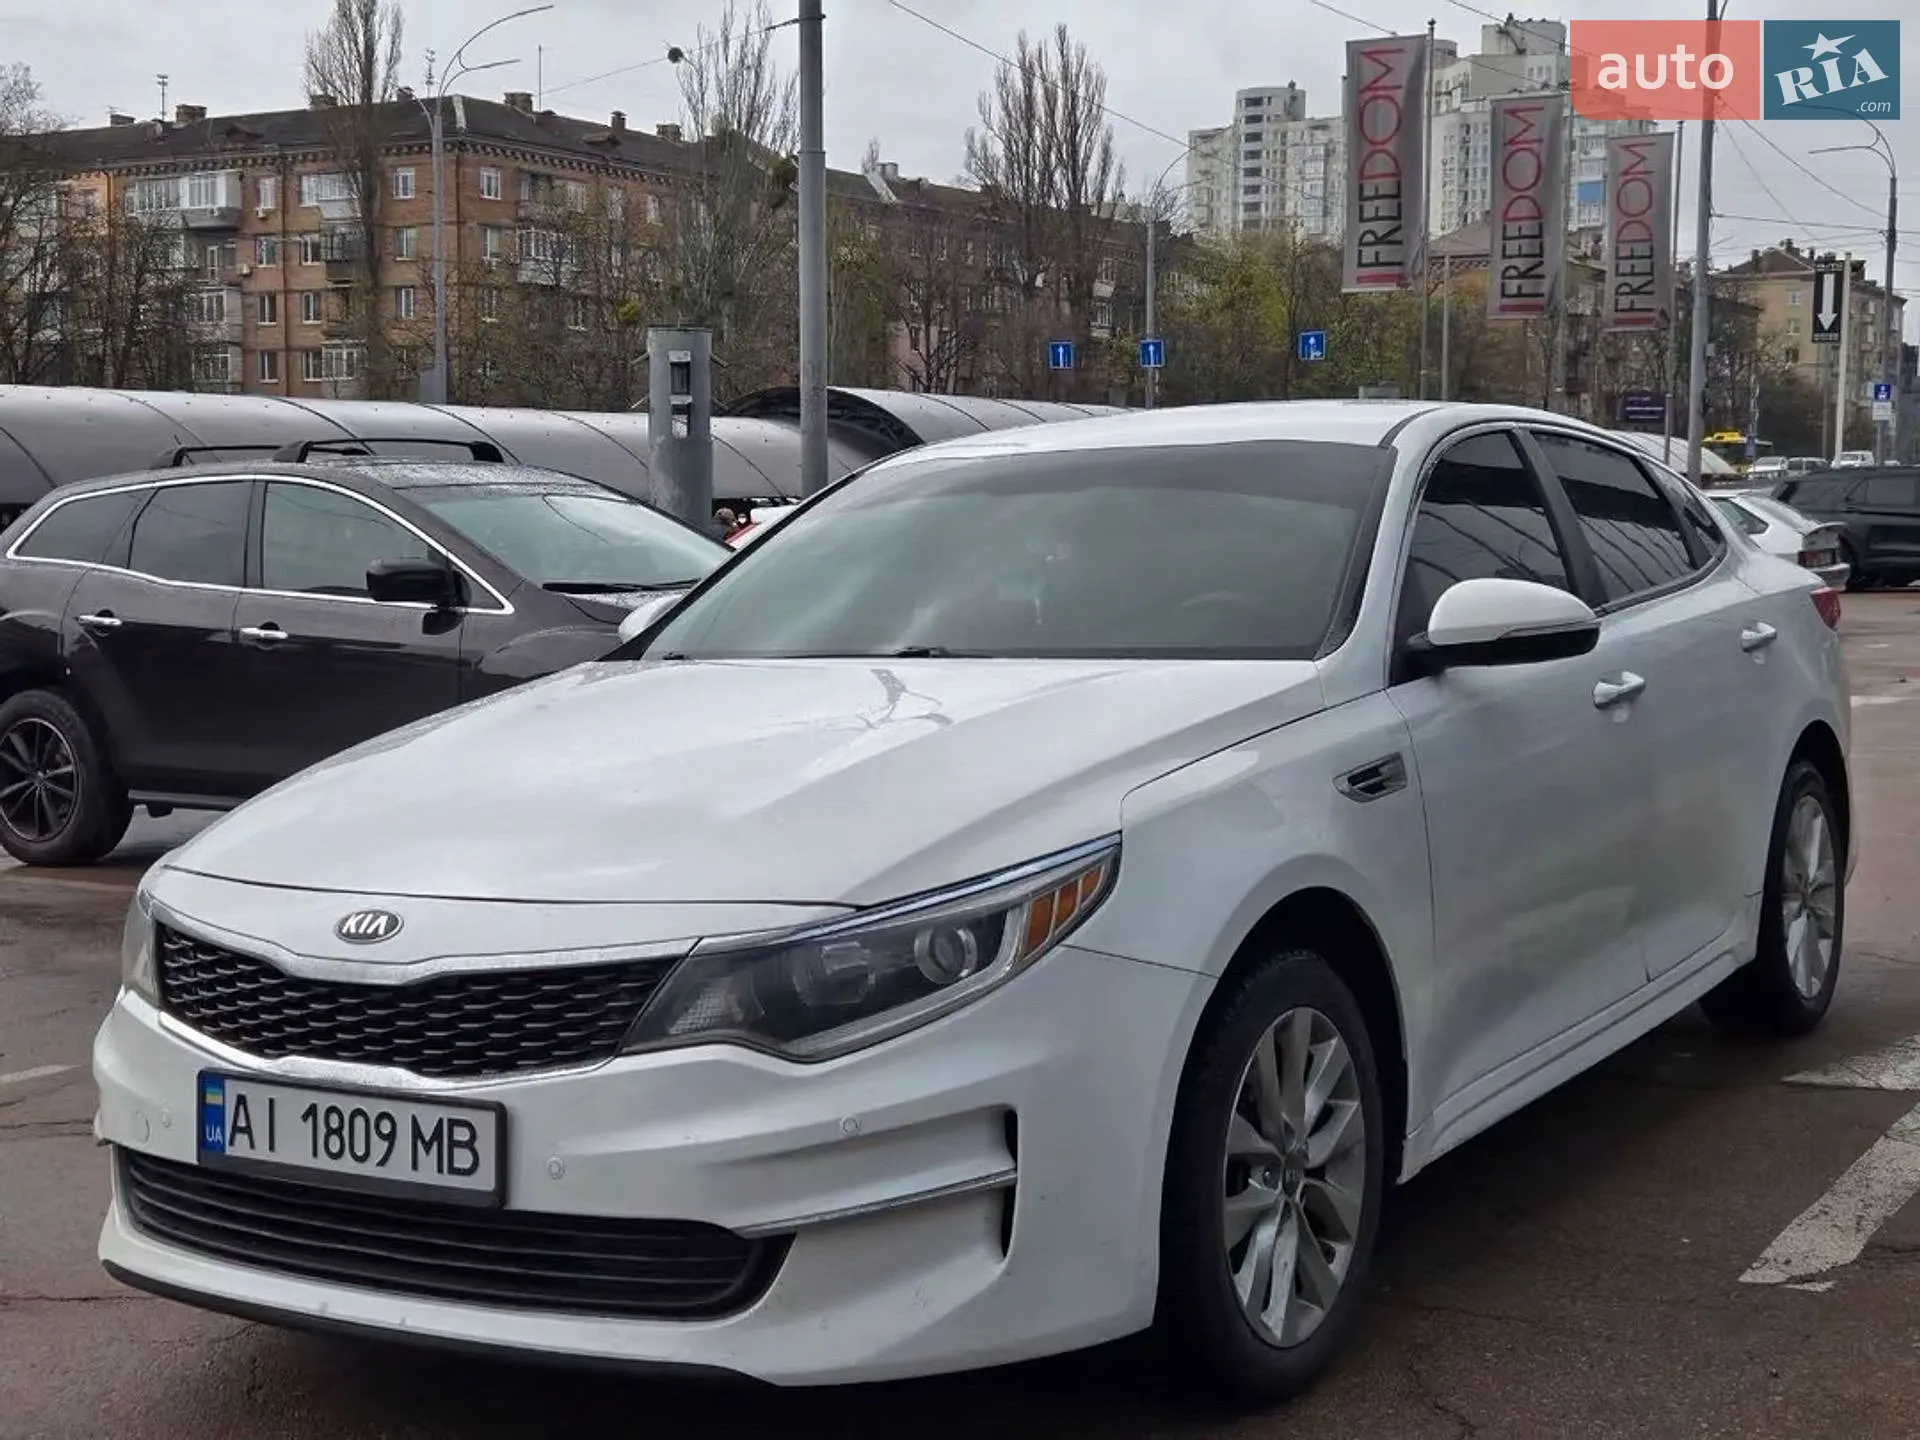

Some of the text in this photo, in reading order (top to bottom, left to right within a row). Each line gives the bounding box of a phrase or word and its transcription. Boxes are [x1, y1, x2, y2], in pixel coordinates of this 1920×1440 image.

[1356, 47, 1405, 269] FREEDOM
[1500, 105, 1546, 299] FREEDOM
[1614, 141, 1656, 313] FREEDOM
[341, 913, 389, 935] KIA
[205, 1124, 224, 1144] UA
[228, 1093, 480, 1177] AI 1809 MB
